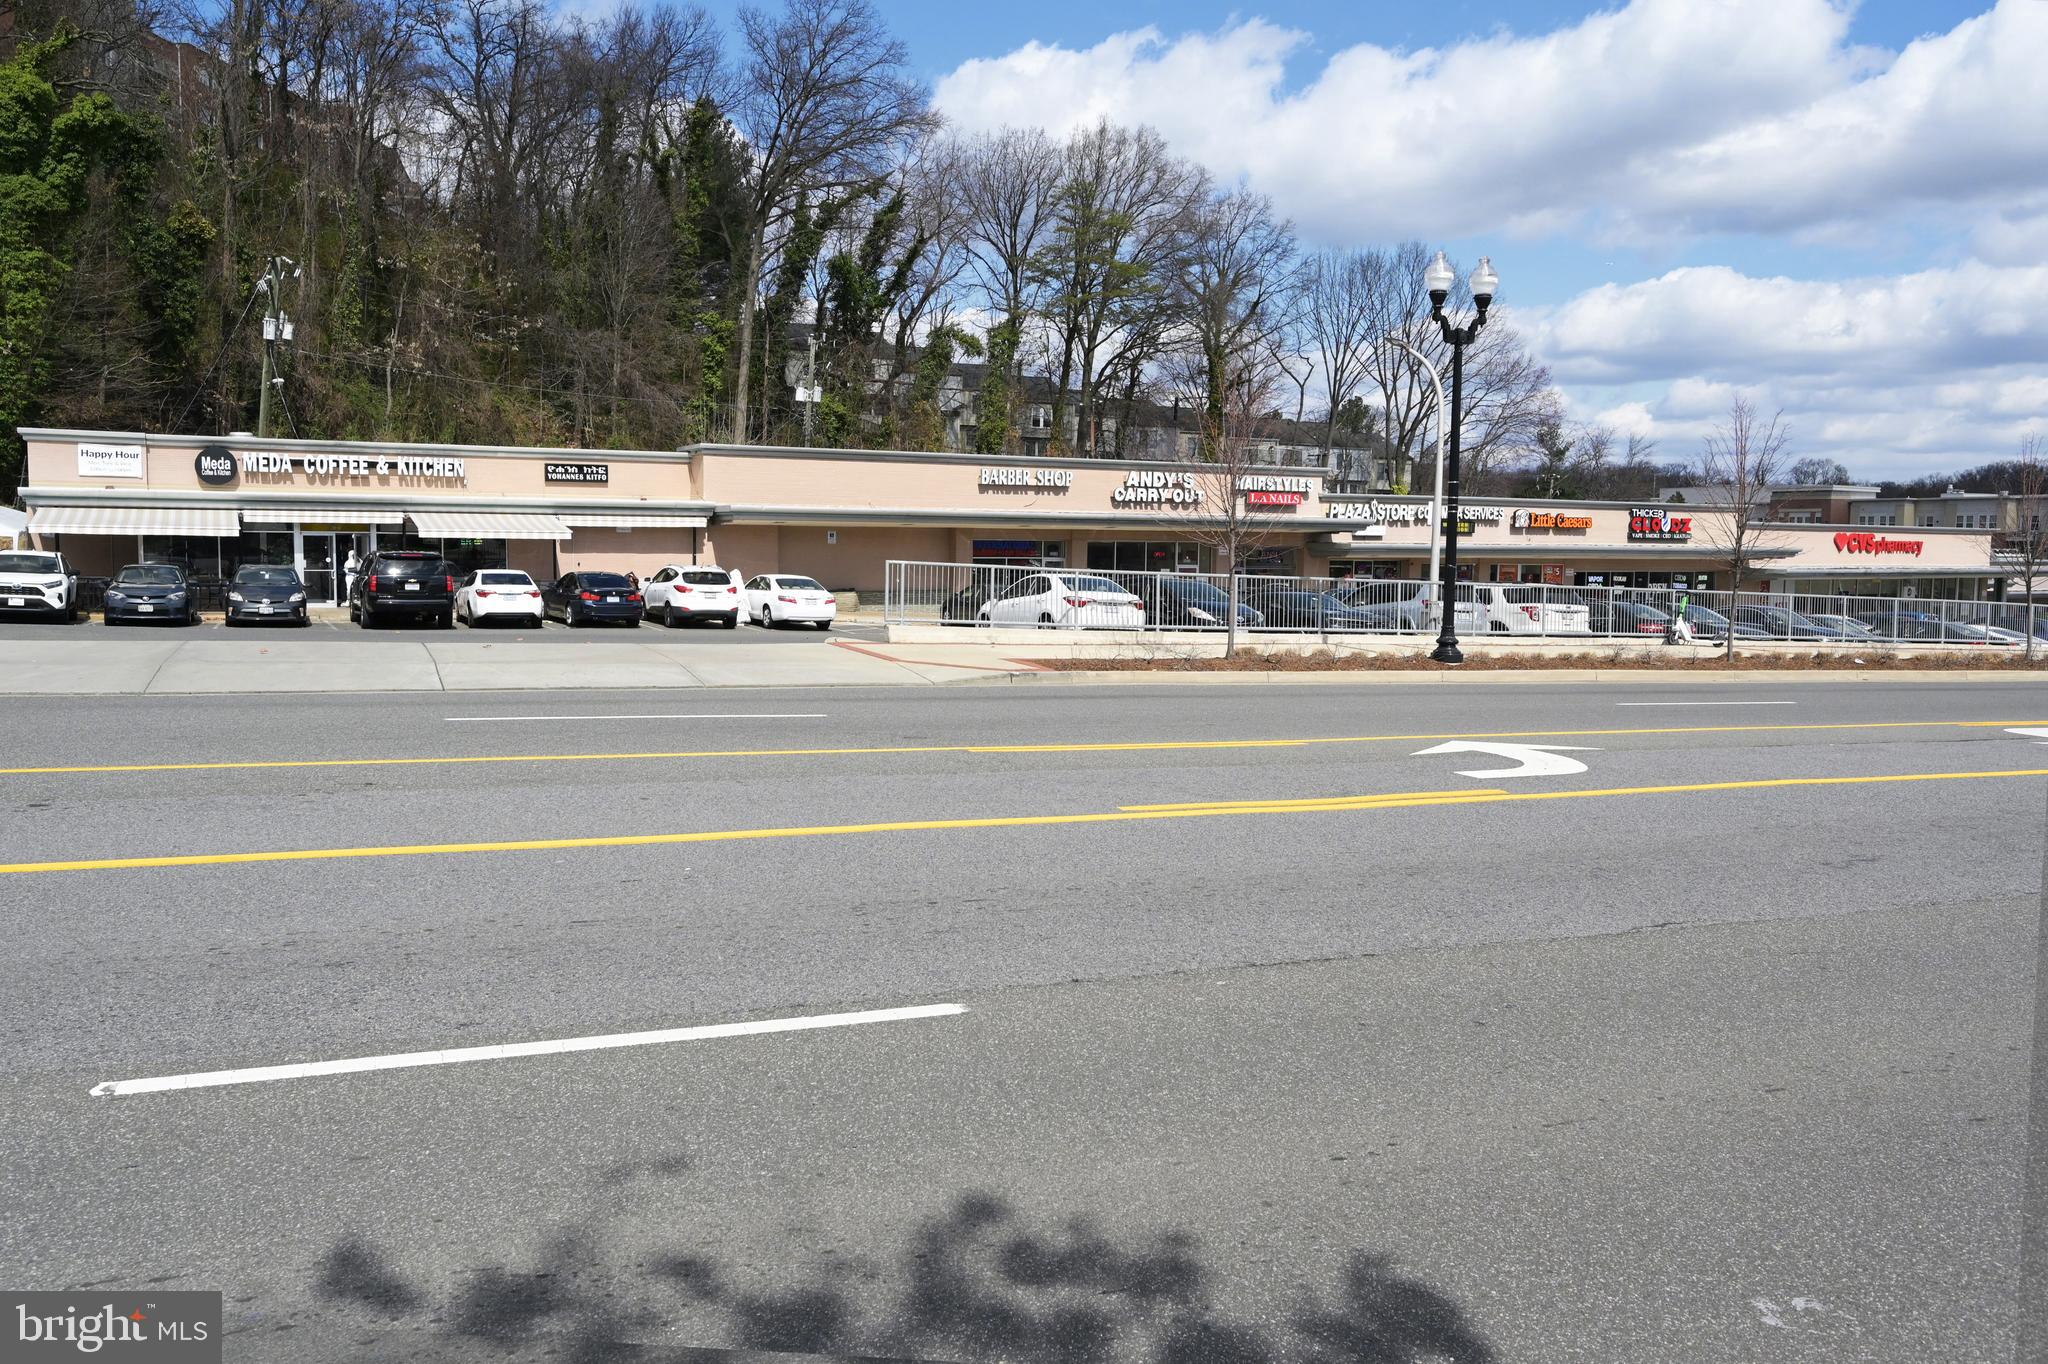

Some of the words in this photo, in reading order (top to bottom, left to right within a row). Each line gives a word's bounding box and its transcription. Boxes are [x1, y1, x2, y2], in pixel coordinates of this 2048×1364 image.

[81, 449, 113, 459] Happy
[115, 450, 140, 459] Hour
[201, 456, 231, 470] Meda
[243, 452, 292, 474] MEDA
[304, 454, 370, 475] COFFEE
[376, 455, 389, 475] &
[397, 457, 465, 477] KITCHEN
[981, 468, 1033, 486] BARBER
[1036, 470, 1074, 487] SHOP
[1126, 471, 1194, 488] ANDY'S
[1235, 474, 1313, 492] HAIRSTYLES
[1114, 488, 1168, 502] CARRY
[1172, 488, 1205, 503] OUT
[1269, 493, 1301, 504] NAILS
[1463, 506, 1505, 520] SERVICES
[1531, 511, 1555, 527] Little
[1557, 512, 1592, 528] Caesars
[1631, 508, 1665, 518] THICKER
[1631, 516, 1693, 532] CLOUDZ
[1848, 533, 1876, 554] CVS
[1875, 536, 1923, 557] pharmacy
[1588, 575, 1604, 583] VAPOR
